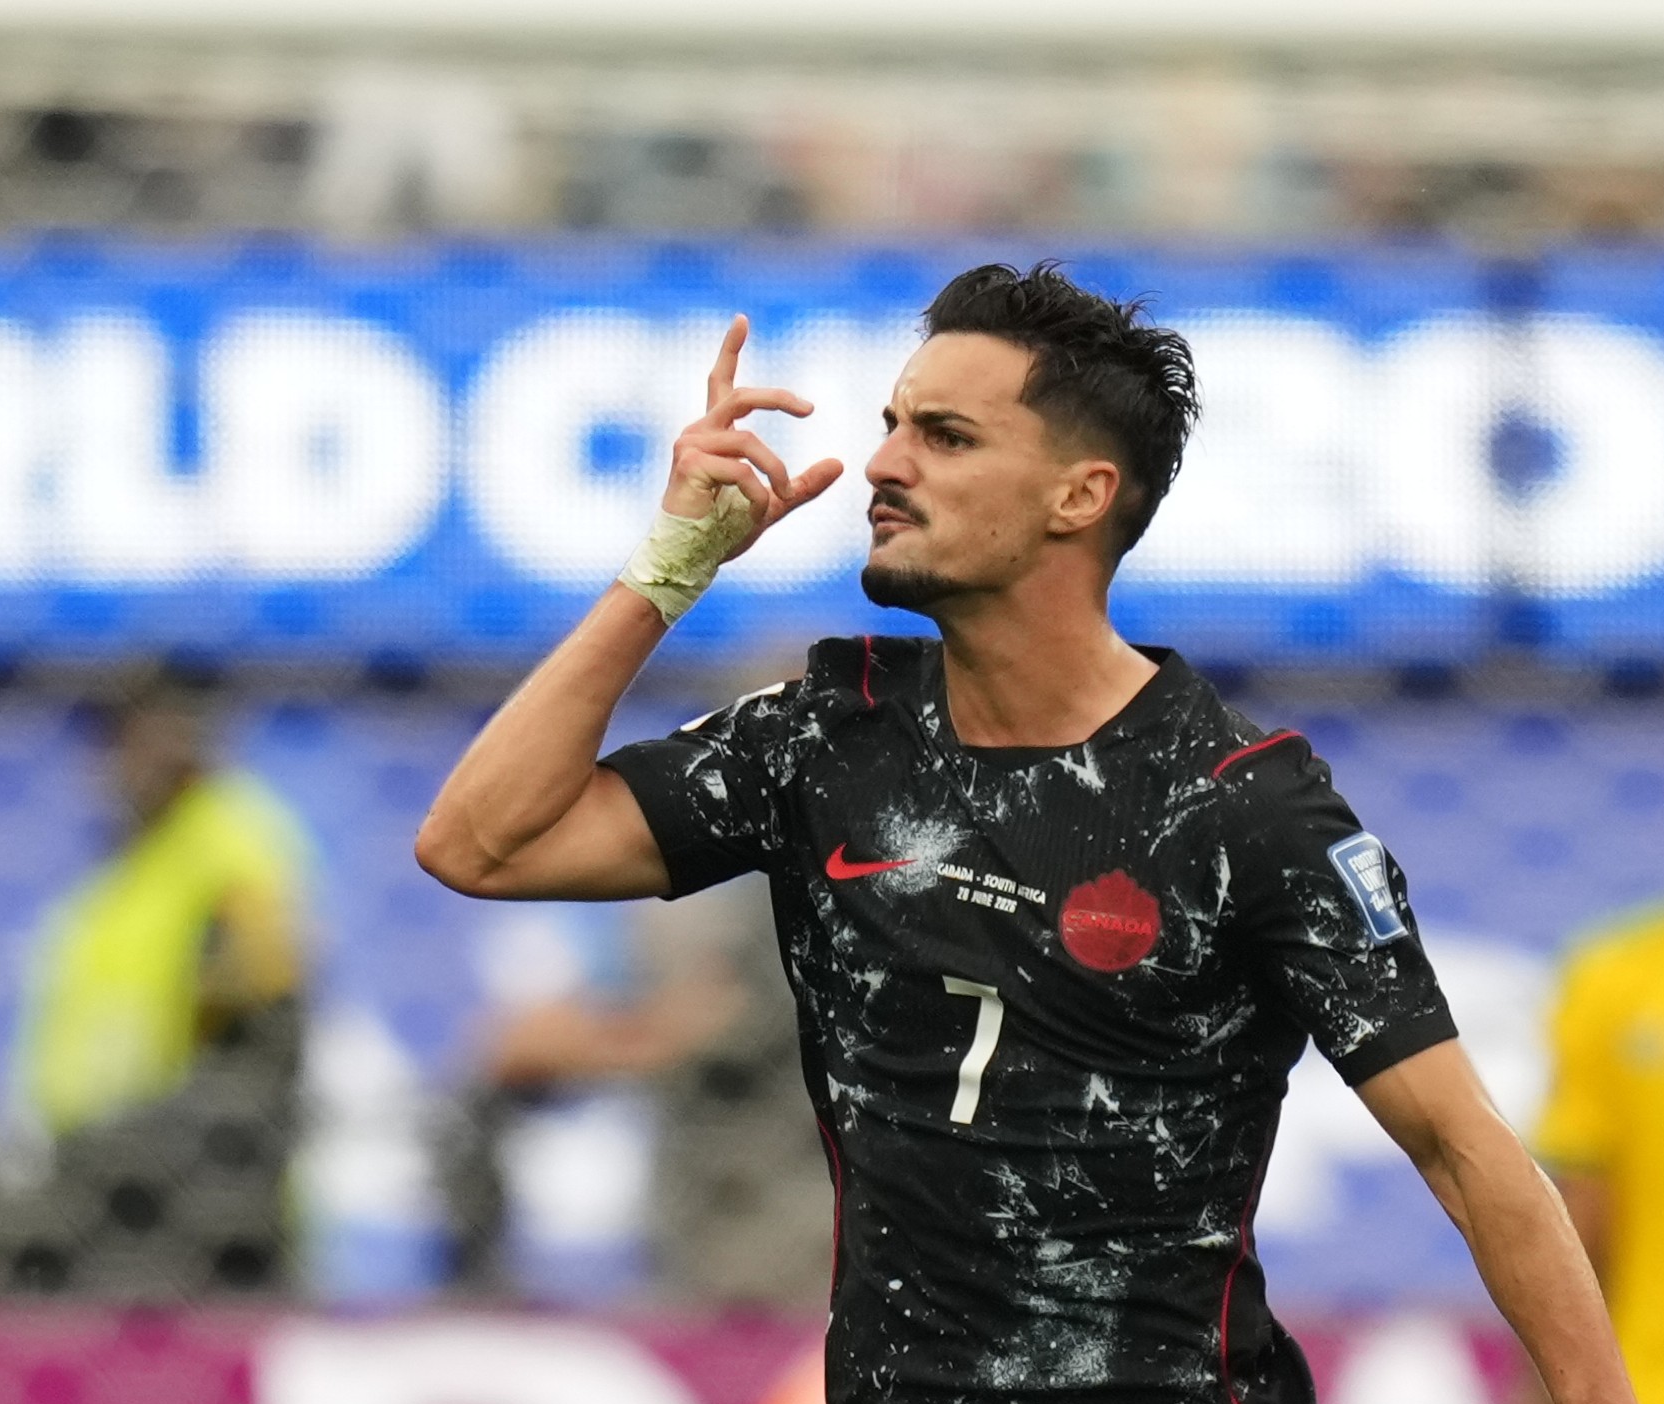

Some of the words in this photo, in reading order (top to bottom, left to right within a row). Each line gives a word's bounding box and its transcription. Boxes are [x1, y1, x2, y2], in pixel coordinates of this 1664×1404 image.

[936, 862, 974, 882] CANADA
[983, 873, 1016, 894] SOUTH
[957, 886, 970, 901] 28
[1065, 909, 1152, 935] CANADA
[942, 975, 1004, 1125] 7
